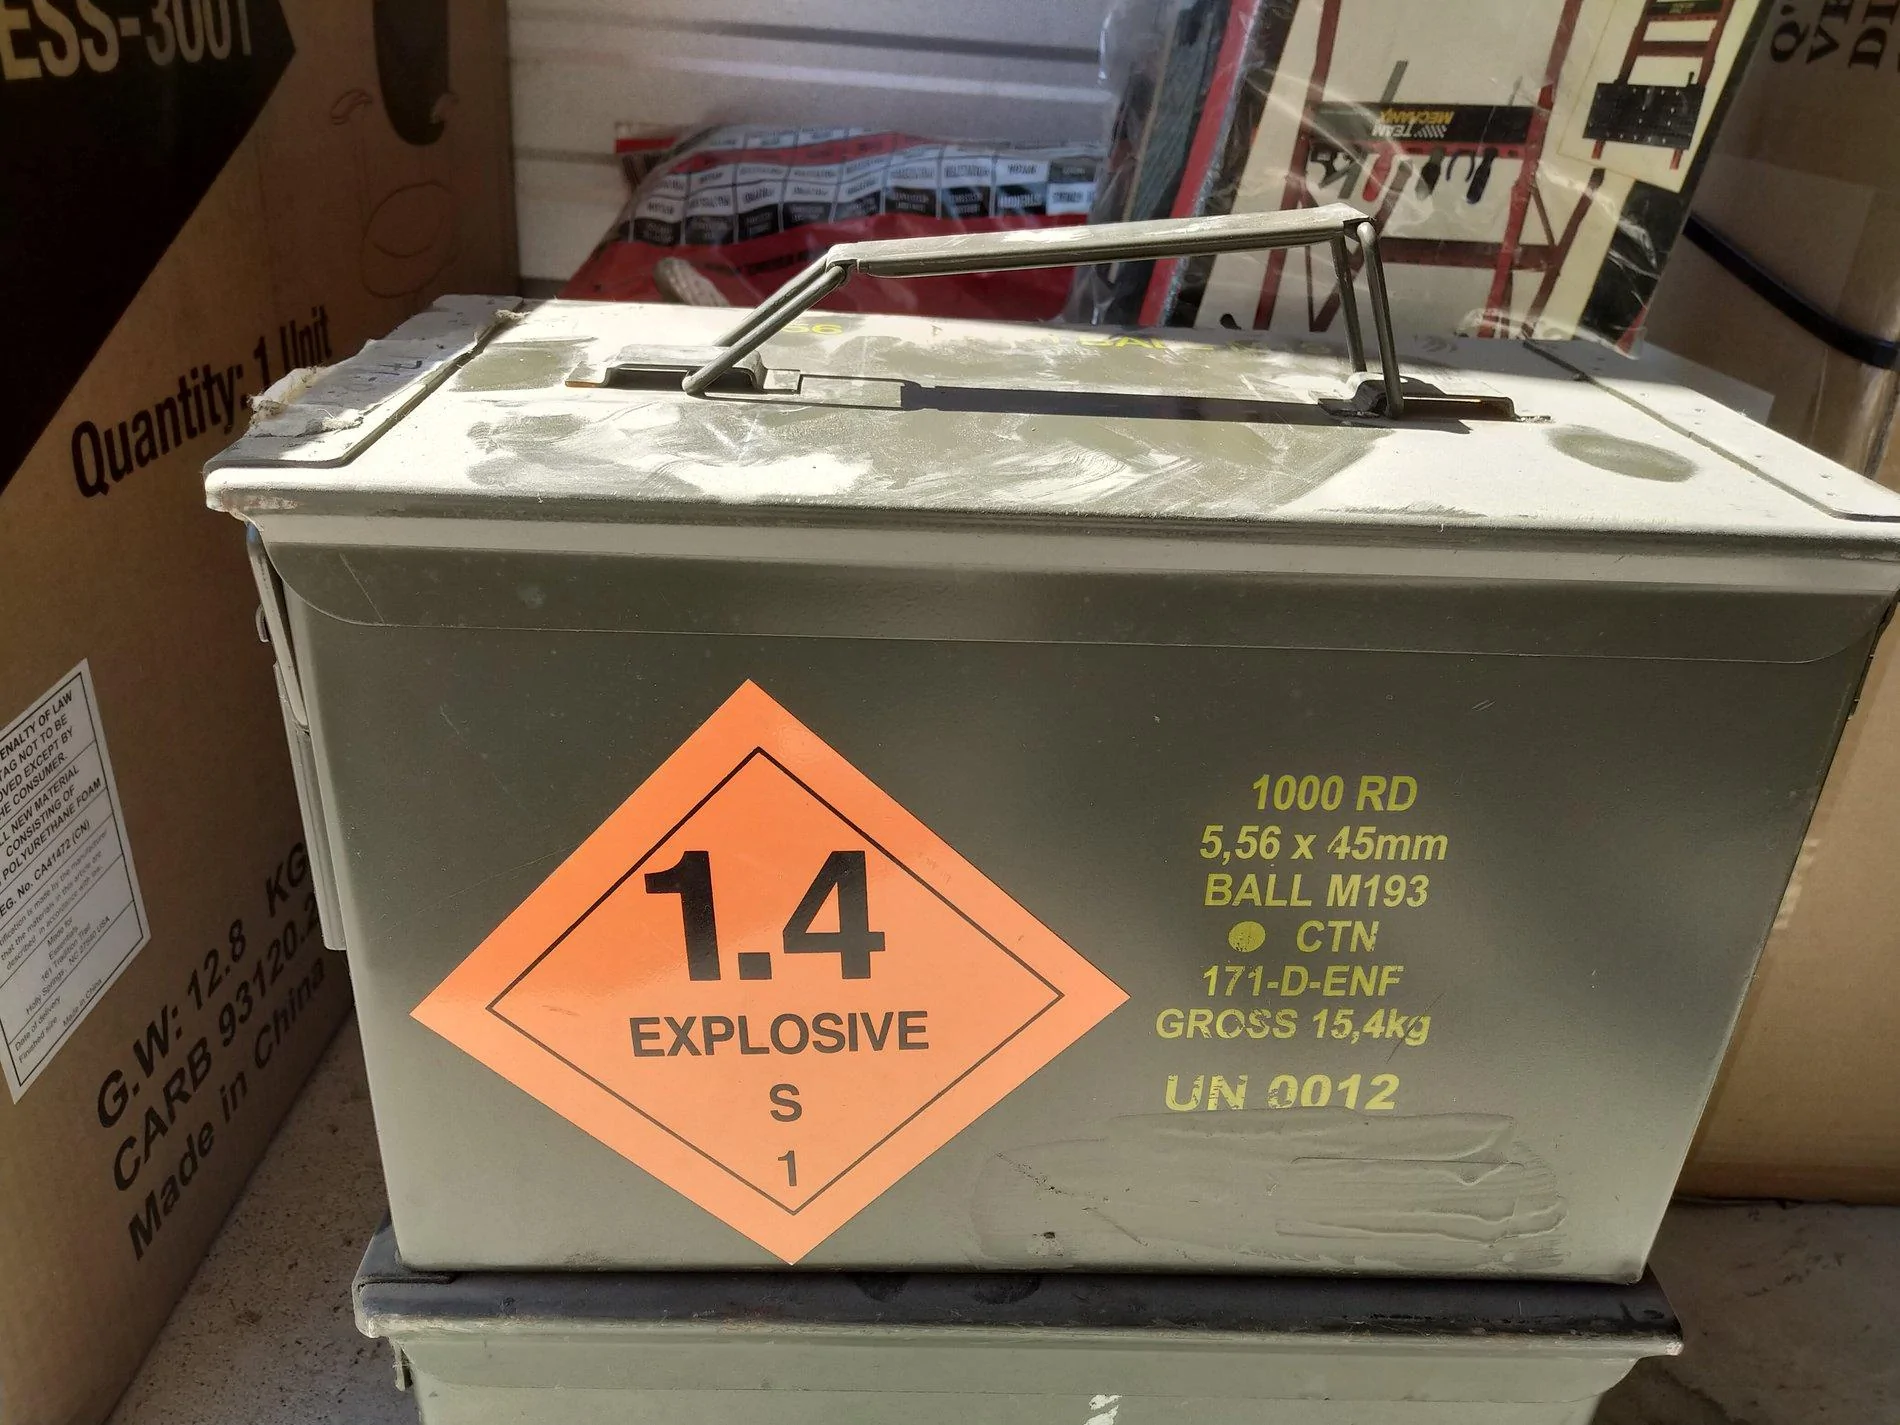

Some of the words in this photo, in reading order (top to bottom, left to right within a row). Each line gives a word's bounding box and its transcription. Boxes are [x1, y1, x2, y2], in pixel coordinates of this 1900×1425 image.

[71, 363, 253, 498] Quantity:
[279, 304, 333, 373] Unit
[38, 709, 52, 726] OF
[52, 689, 73, 714] LAW
[18, 738, 38, 763] NOT
[40, 727, 53, 743] TO
[54, 713, 68, 731] BE
[24, 739, 60, 778] EXCEPT
[60, 726, 73, 744] BY
[11, 805, 33, 834] NEW
[34, 765, 80, 811] MATERIAL
[13, 752, 68, 805] CONSUMER.
[1253, 774, 1344, 811] 1000
[1355, 775, 1418, 811] RD
[2, 803, 76, 880] POLYURETHANE
[76, 777, 101, 807] FOAM
[6, 798, 62, 857] CONSISTING
[62, 784, 76, 802] OF
[17, 882, 34, 899] No.
[33, 838, 71, 881] CA41472
[72, 819, 90, 845] (CN)
[1200, 825, 1282, 865] 5,56
[1290, 834, 1317, 860] x
[1327, 826, 1448, 861] 45mm
[1204, 873, 1312, 907] BALL
[1326, 874, 1430, 908] M193
[46, 926, 65, 948] Made
[644, 850, 886, 982] 1.4
[1296, 920, 1379, 953] CTN
[15, 932, 26, 946] the
[97, 1004, 183, 1129] G.W:
[187, 918, 247, 1011] 12.8
[265, 842, 308, 918] KG
[1203, 965, 1404, 997] 171-D-ENF
[15, 1032, 31, 1052] Date
[31, 1021, 38, 1033] of
[629, 1010, 930, 1058] EXPLOSIVE
[1156, 1008, 1299, 1039] GROSS
[1312, 1008, 1432, 1046] 15,4kg
[113, 1036, 213, 1191] CARB
[127, 1121, 215, 1261] Made
[220, 1070, 247, 1124] in
[255, 957, 325, 1070] China
[769, 1083, 803, 1123] S
[1165, 1074, 1248, 1111] UN
[1267, 1073, 1400, 1111] 0012
[777, 1150, 798, 1187] 1
